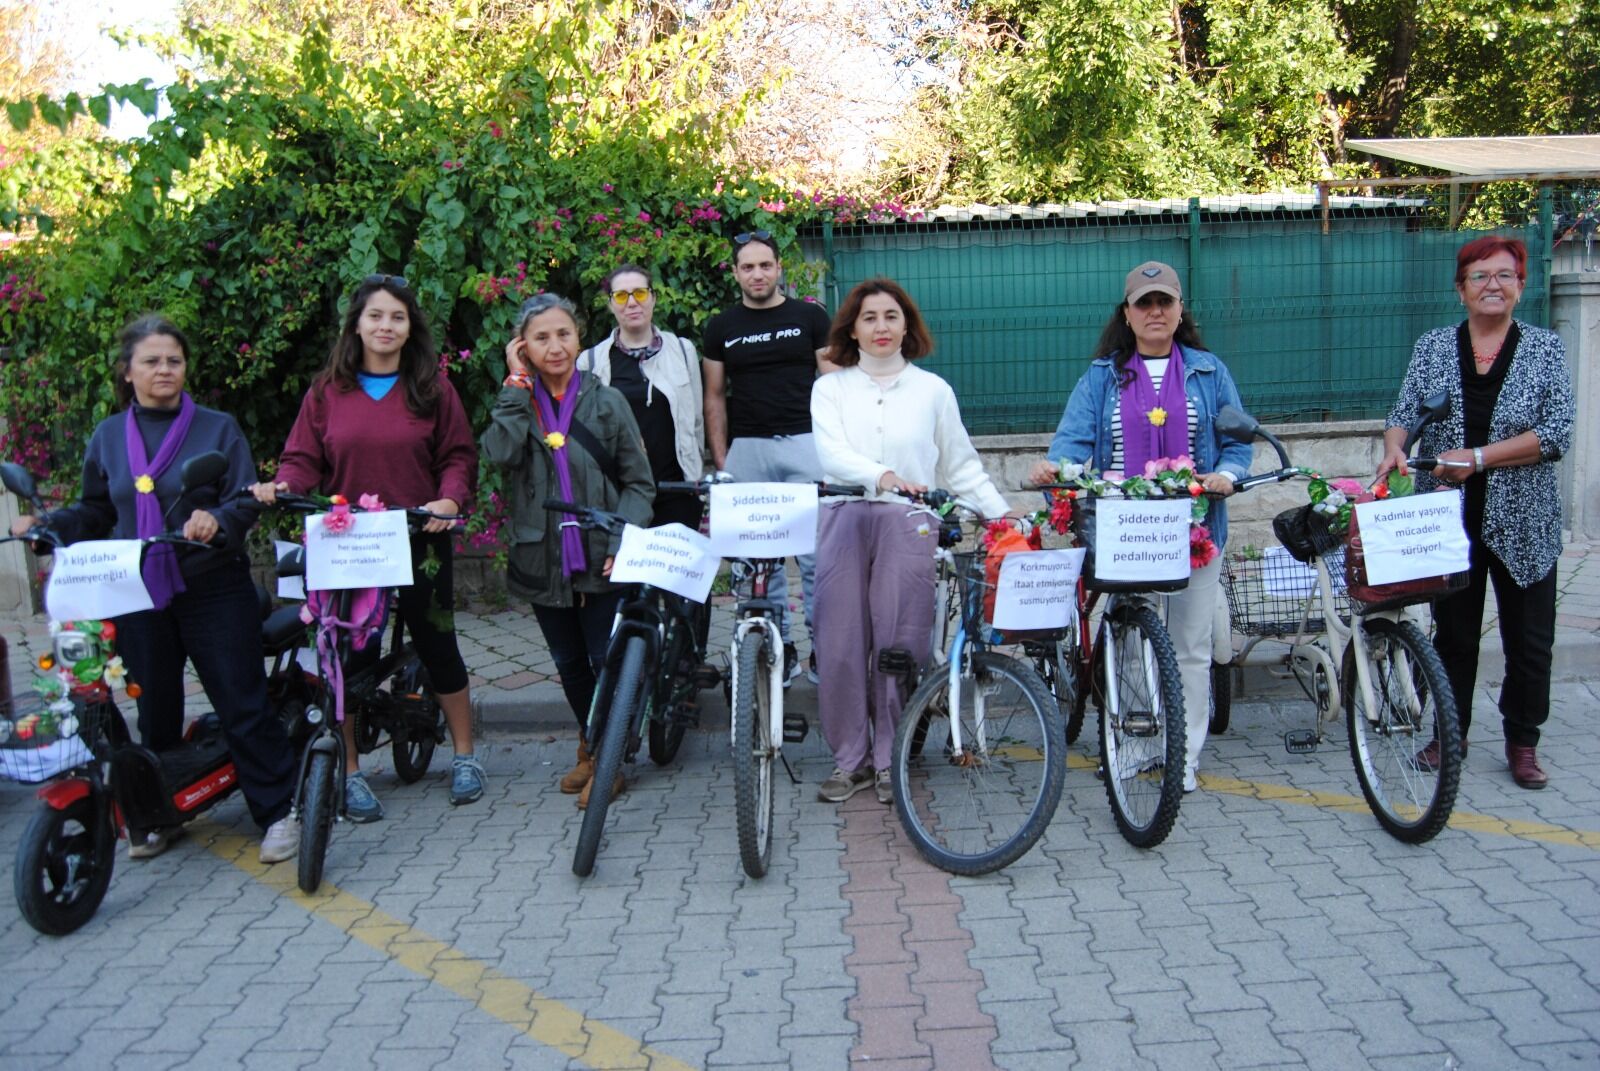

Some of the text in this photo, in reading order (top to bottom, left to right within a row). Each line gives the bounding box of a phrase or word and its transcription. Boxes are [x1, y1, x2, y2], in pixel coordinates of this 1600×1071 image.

[742, 328, 801, 344] NIKE PRO
[732, 494, 796, 507] Şiddetsiz bir
[747, 513, 781, 524] dünya
[1118, 513, 1180, 525] Şiddete dur
[1374, 505, 1453, 523] Kadınlar yaşıyor,
[738, 530, 790, 541] mümkün!
[1395, 523, 1441, 538] mücadele
[1119, 532, 1178, 544] demek için
[646, 543, 693, 560] dönüyor,
[1401, 541, 1441, 556] sürüyor!
[90, 552, 117, 563] daha
[1113, 549, 1181, 563] pedallıyoruz!
[667, 564, 705, 581] geliyor!
